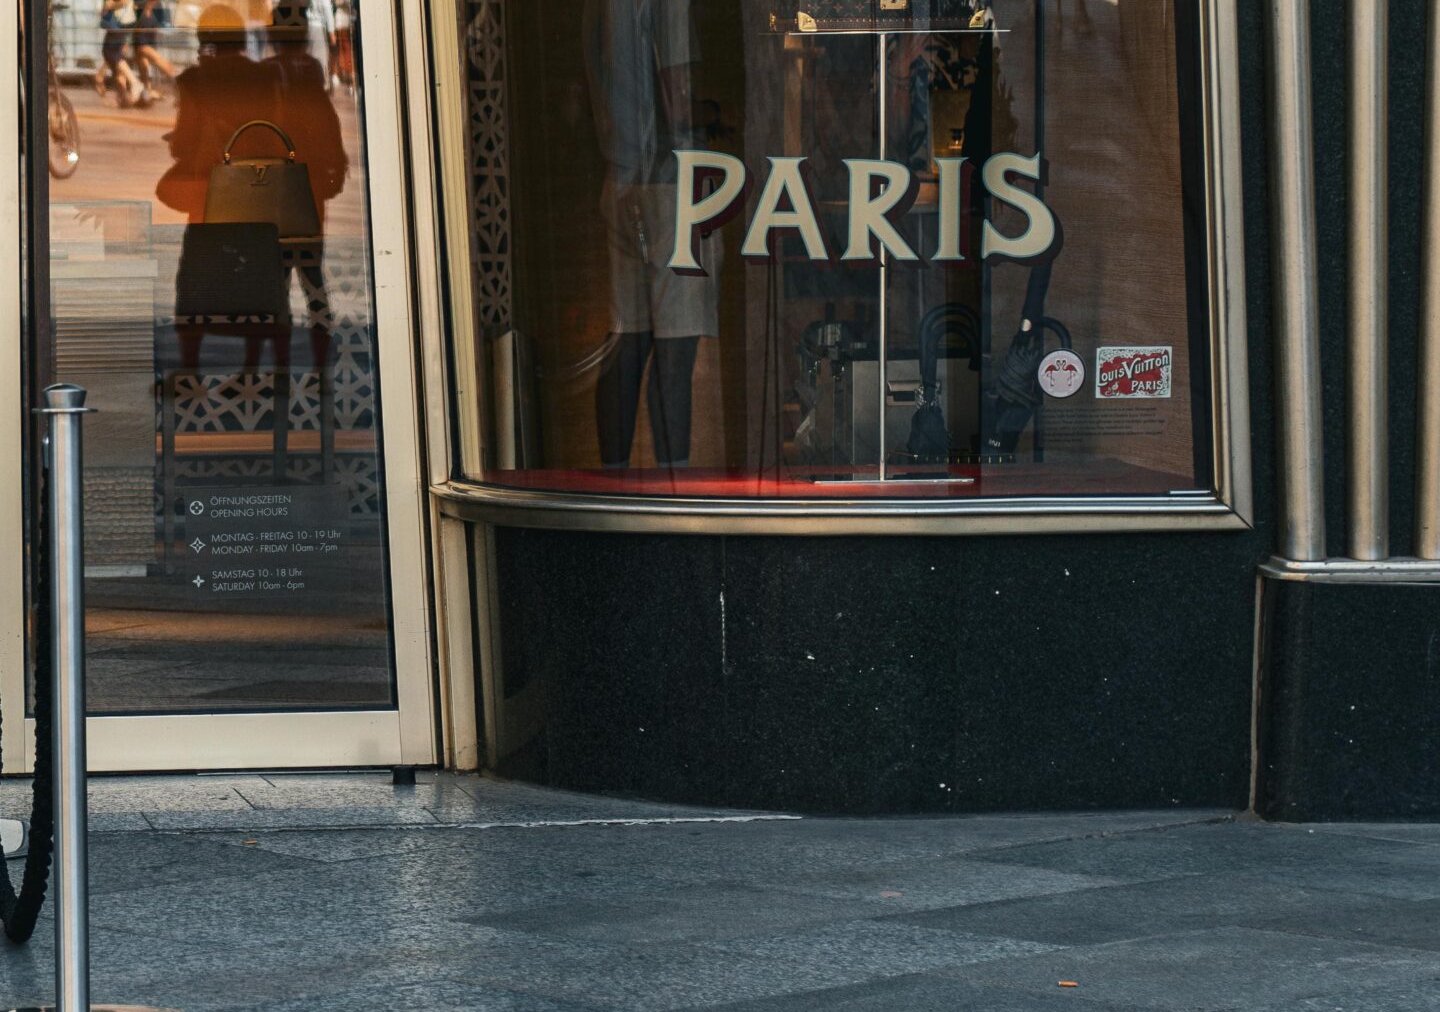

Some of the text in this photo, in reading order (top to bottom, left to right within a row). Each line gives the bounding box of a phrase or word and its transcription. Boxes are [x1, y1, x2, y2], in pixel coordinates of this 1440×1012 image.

[667, 149, 1064, 277] PARIS
[1131, 380, 1164, 391] PARIS
[210, 495, 292, 506] ÖFFNUNGSZEITEN
[211, 507, 289, 518] OPENING HOURS
[211, 533, 254, 543] MONTAG
[260, 531, 294, 541] FREITAG
[297, 531, 308, 540] 10
[314, 530, 325, 539] 19
[327, 529, 341, 539] Uhr
[211, 545, 254, 555] MONDAY
[260, 544, 288, 553] FRIDAY
[292, 544, 314, 552] 10am
[319, 543, 338, 553] 7pm
[212, 570, 255, 580] SAMSTAG
[258, 569, 269, 577] 10
[276, 569, 287, 577] 18
[288, 567, 303, 577] Uhr
[212, 582, 255, 592] SATURDAY
[258, 581, 280, 590] 10am
[287, 581, 305, 591] 6pm
